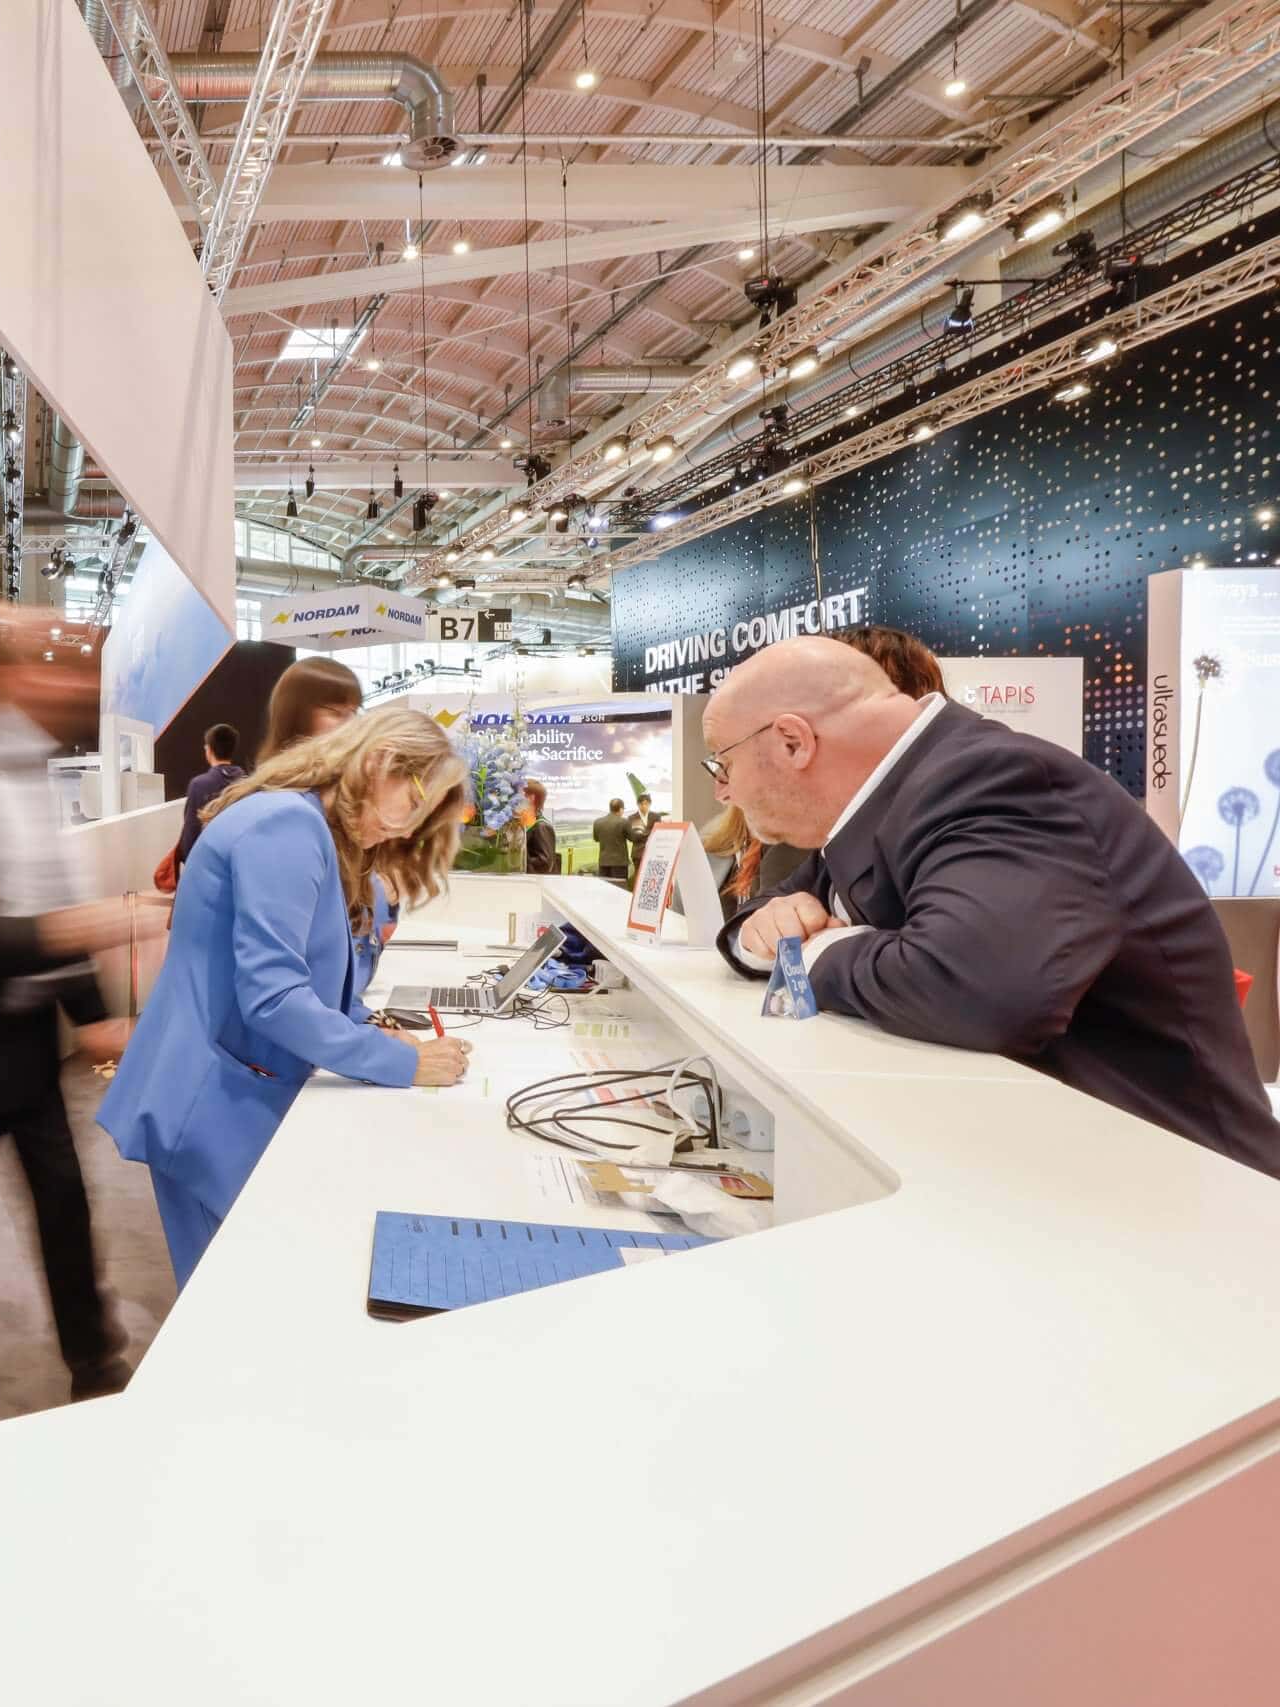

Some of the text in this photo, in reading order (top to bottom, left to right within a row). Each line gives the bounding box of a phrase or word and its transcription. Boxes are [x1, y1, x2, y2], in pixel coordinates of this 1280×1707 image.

[293, 604, 360, 622] NORDAM
[387, 608, 422, 625] NORDAM
[440, 617, 475, 640] B7
[645, 587, 865, 674] DRIVING COMFORT
[980, 686, 1035, 704] TAPIS
[1152, 674, 1174, 789] ultrasuede
[541, 746, 603, 761] Sacrifice
